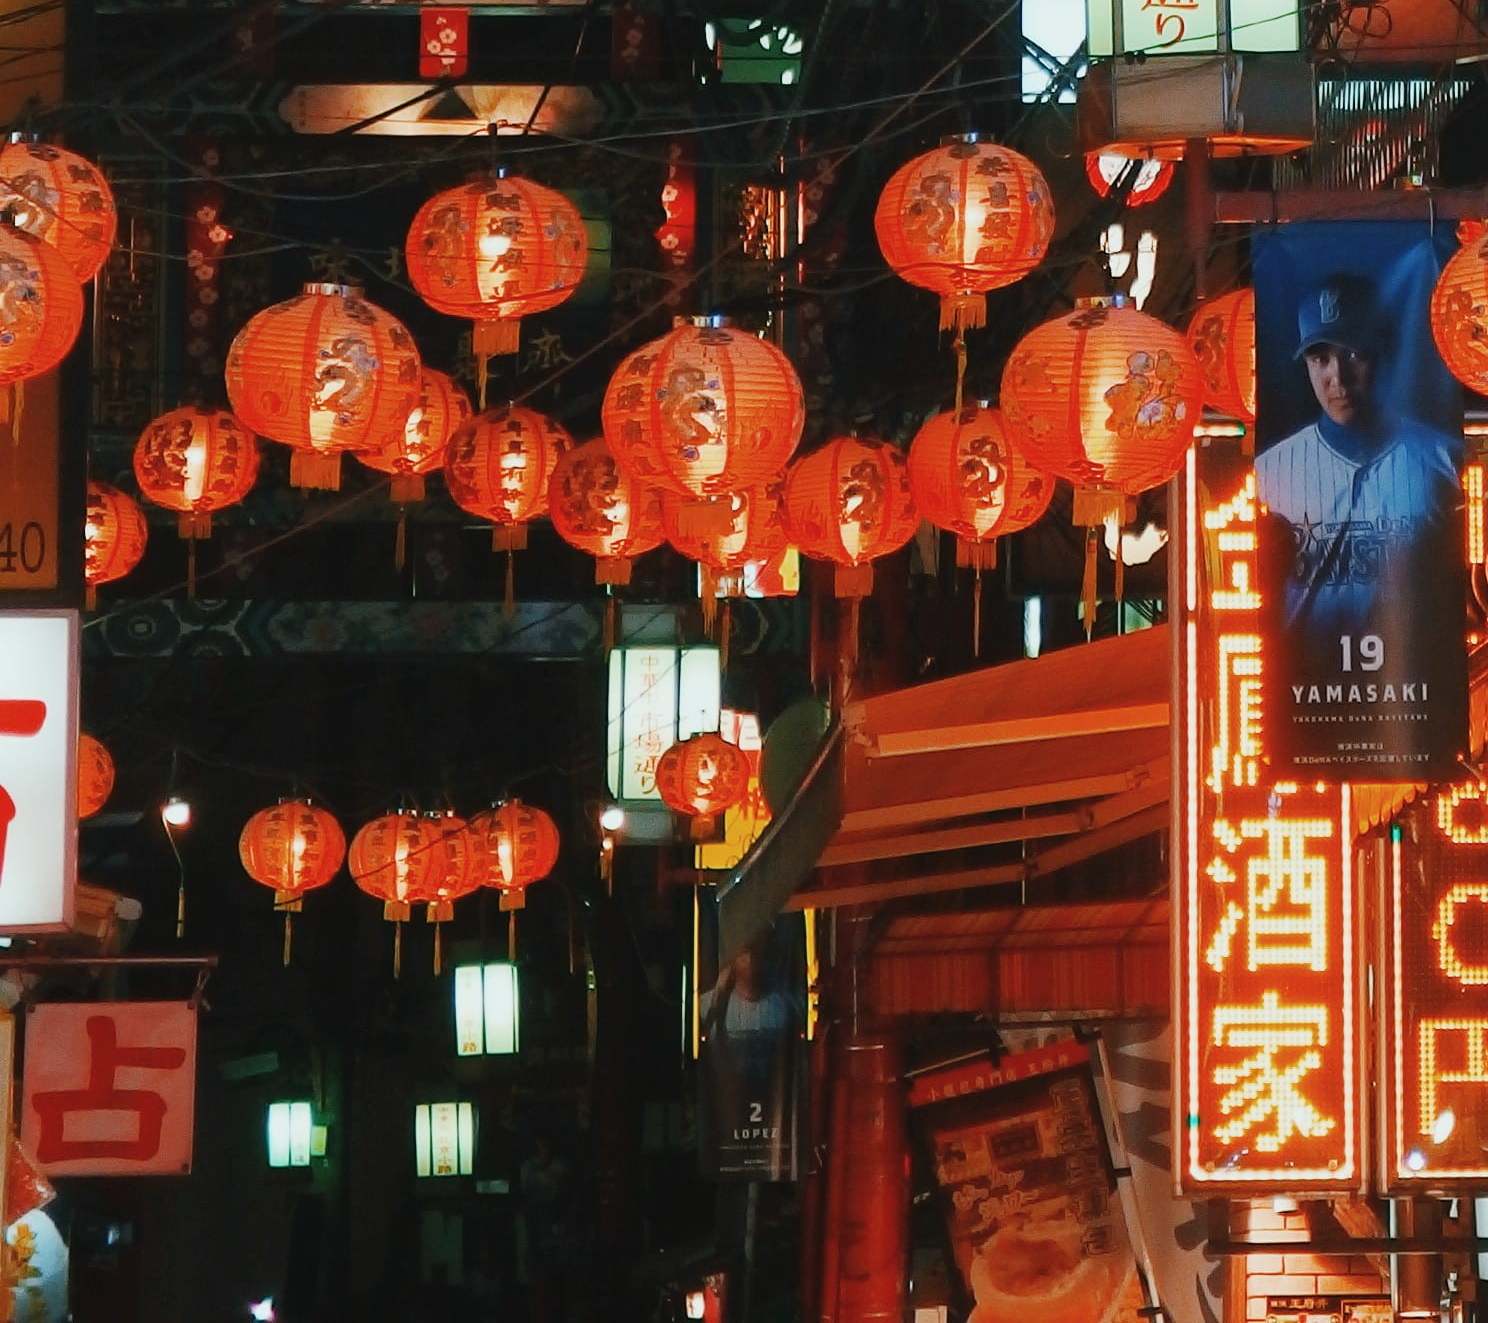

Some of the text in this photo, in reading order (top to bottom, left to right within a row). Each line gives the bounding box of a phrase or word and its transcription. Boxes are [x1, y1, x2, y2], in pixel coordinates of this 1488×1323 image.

[1339, 634, 1386, 673] 19
[1292, 683, 1429, 704] YAMASAKI
[32, 1015, 186, 1161] 占
[749, 1102, 763, 1123] 2
[733, 1127, 780, 1140] LOPEZ
